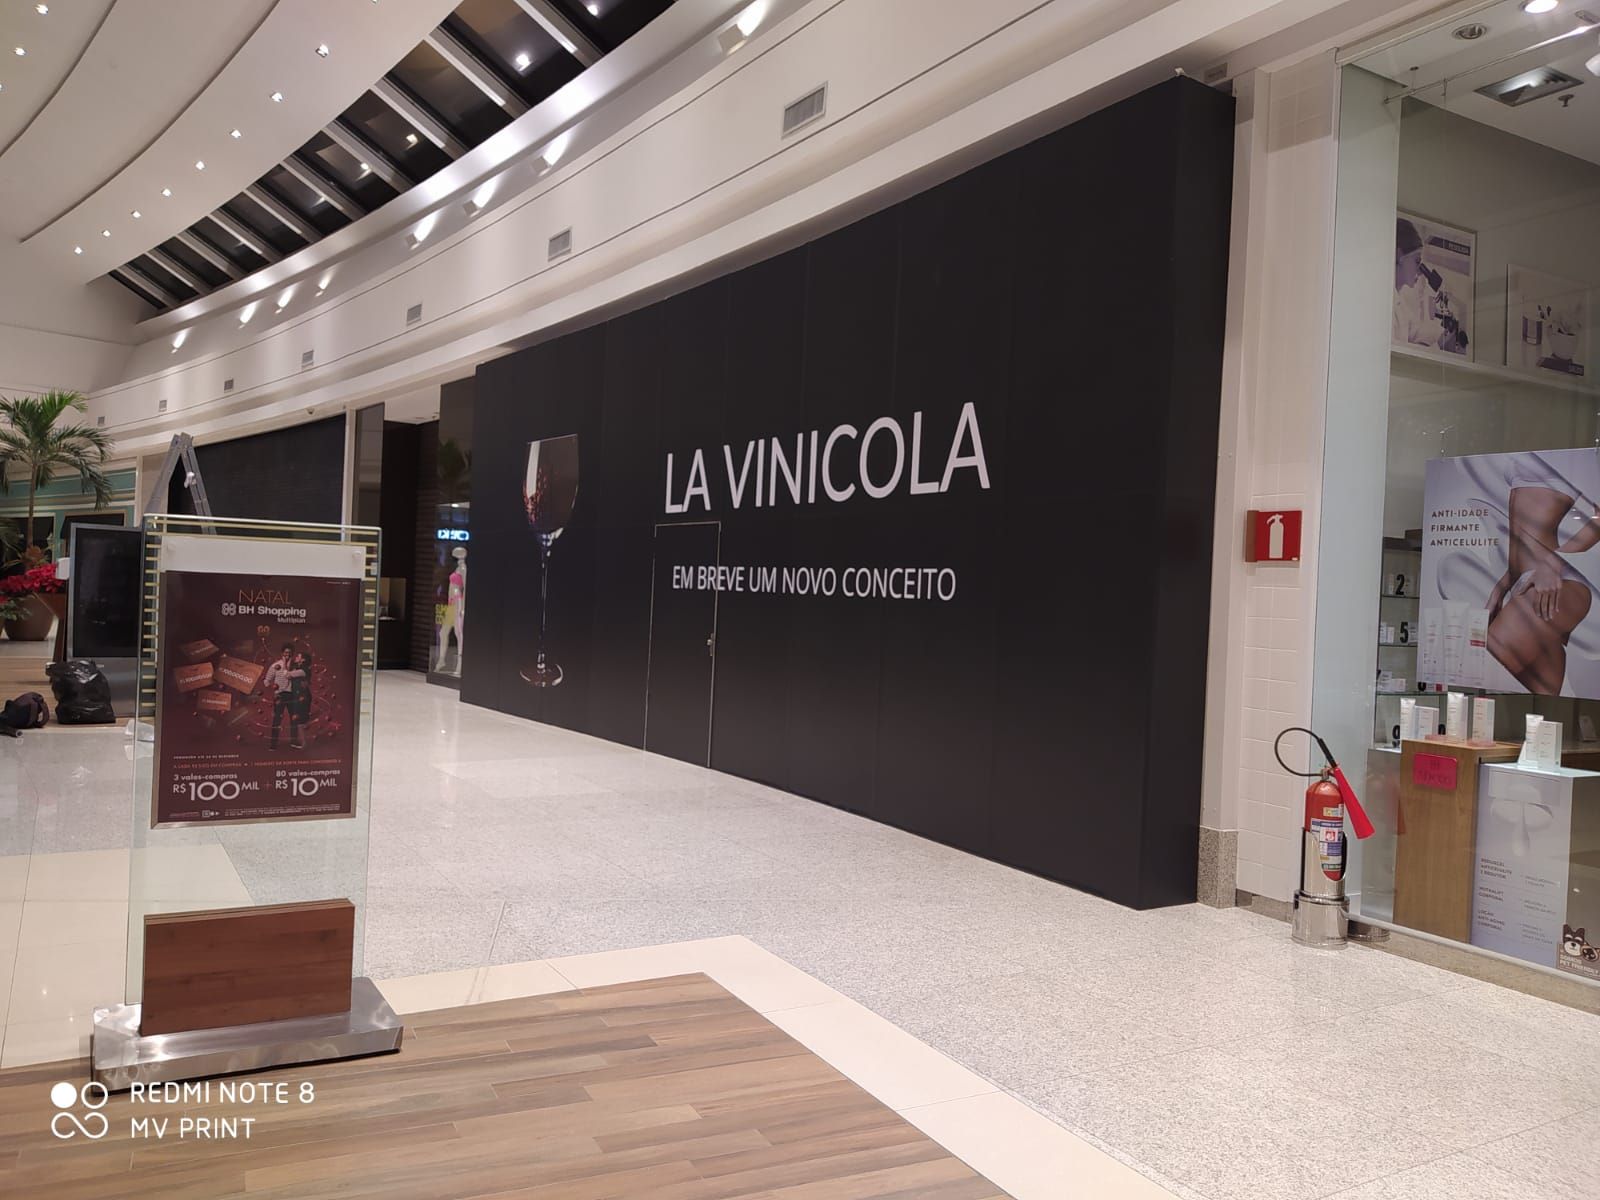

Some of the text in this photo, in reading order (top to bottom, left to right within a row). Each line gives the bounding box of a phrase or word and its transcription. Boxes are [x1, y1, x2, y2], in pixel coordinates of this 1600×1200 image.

[665, 402, 991, 514] LA VINICOLA
[1431, 508, 1489, 518] ANTI-IDADE
[1431, 523, 1480, 532] FIRMANTE
[1430, 537, 1500, 547] ANTICELULITE
[672, 565, 957, 601] EM BREVE UM NOVO CONCEITO
[1395, 574, 1405, 596] 2
[238, 589, 293, 605] NATAL
[238, 605, 307, 618] BH Shopping
[1399, 622, 1409, 644] 5
[181, 772, 238, 781] vales-compras
[275, 768, 341, 777] 80 vales-compras
[172, 780, 260, 801] R$ 100 MIL
[275, 777, 337, 797] R$ 10 MIL
